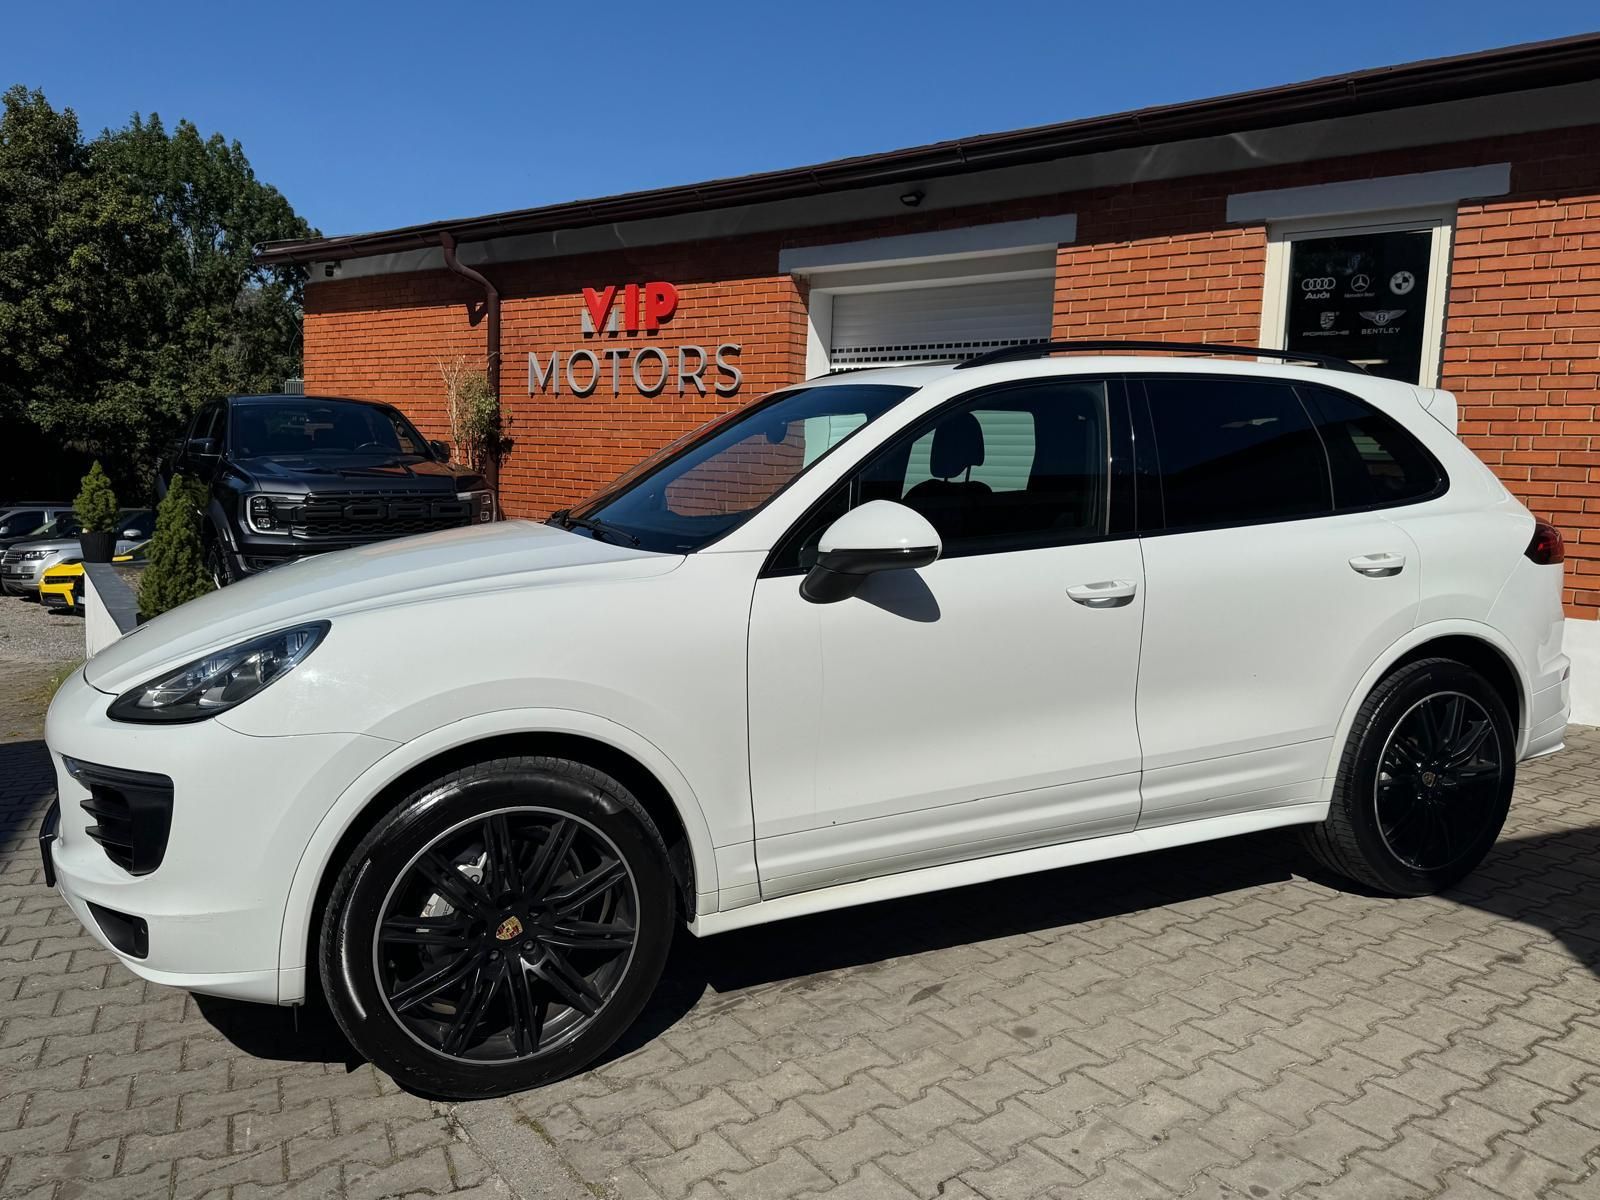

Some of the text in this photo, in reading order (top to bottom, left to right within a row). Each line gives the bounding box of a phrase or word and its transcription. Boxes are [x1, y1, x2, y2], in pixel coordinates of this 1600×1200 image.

[582, 281, 679, 334] VIP
[1305, 291, 1330, 299] Audi
[1361, 327, 1400, 335] BENTLEY
[528, 343, 743, 396] MOTORS
